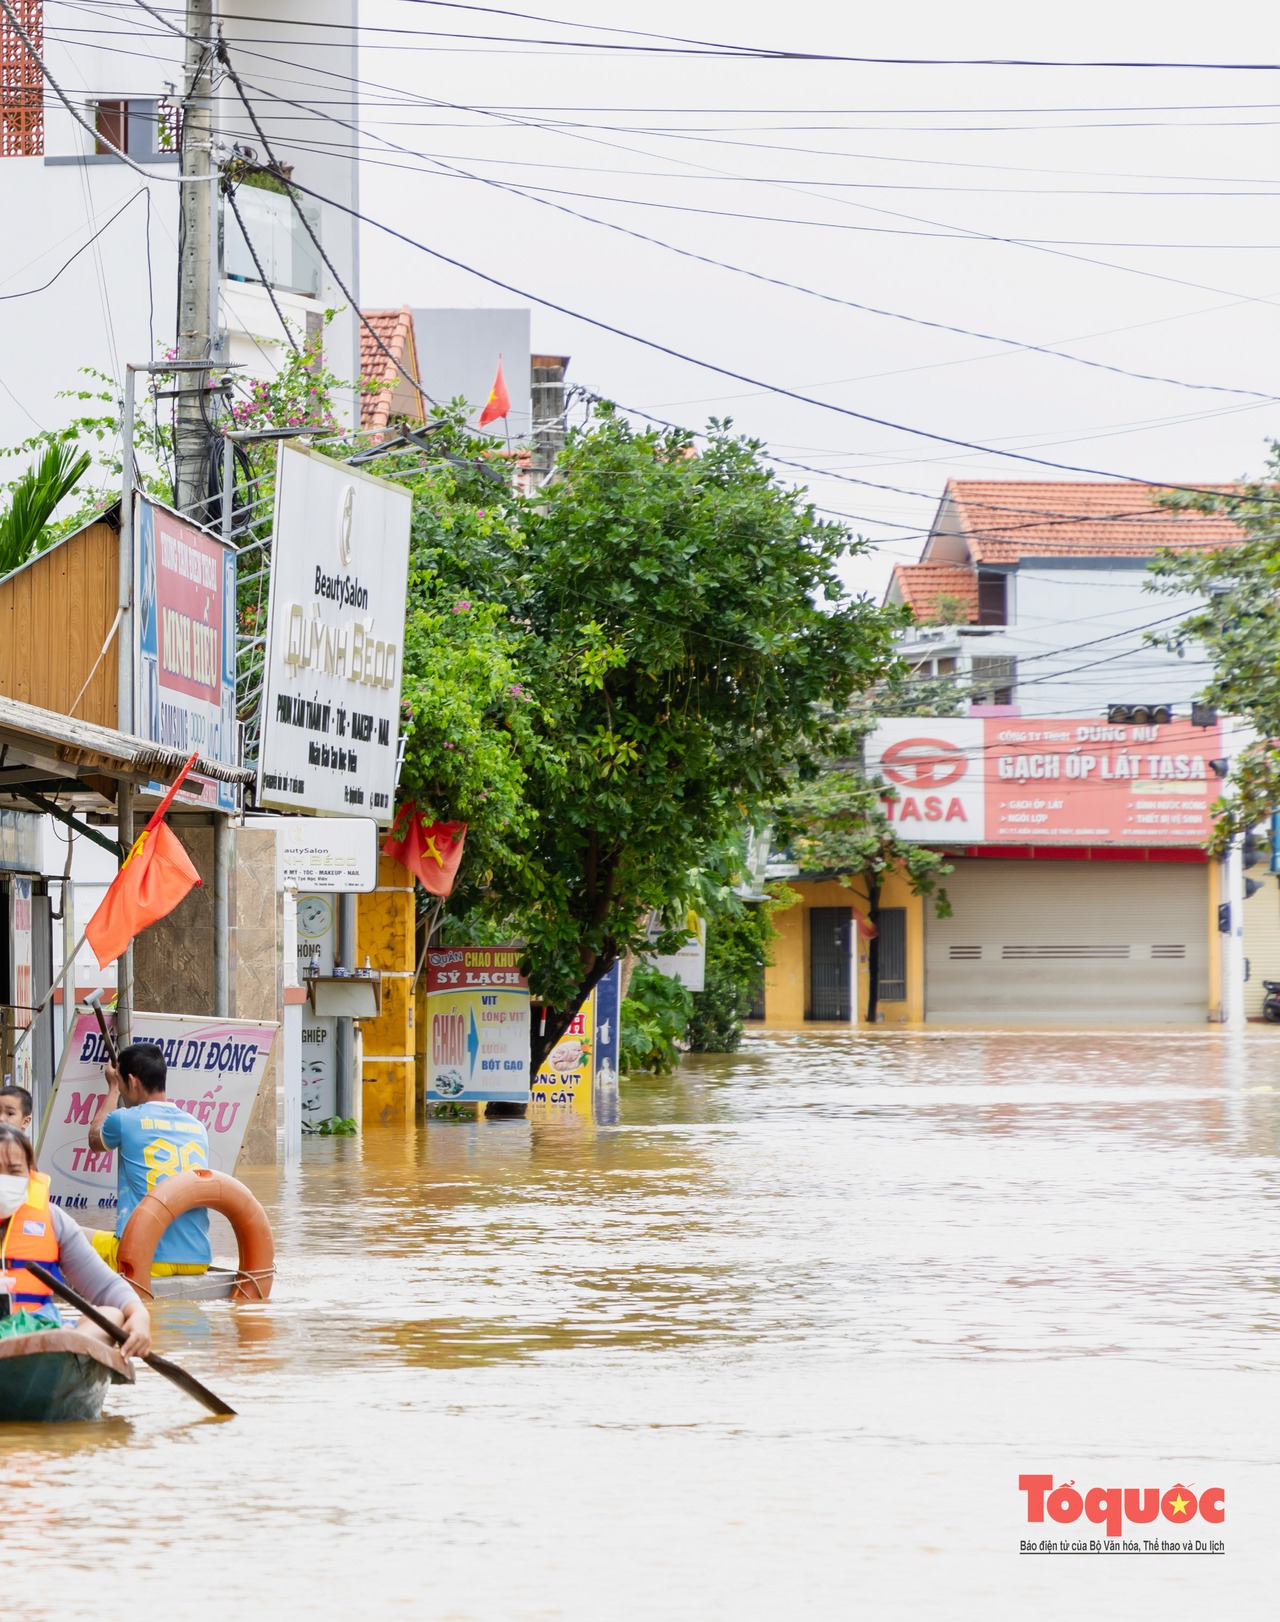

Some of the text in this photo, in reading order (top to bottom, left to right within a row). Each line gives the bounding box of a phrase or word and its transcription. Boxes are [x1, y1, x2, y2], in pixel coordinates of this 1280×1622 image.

[315, 565, 368, 611] BeautySalon
[162, 596, 218, 690] MINH HIẾU
[998, 747, 1206, 784] GẠCH ỐP LÁT TASA
[880, 796, 968, 821] TASA
[297, 940, 321, 958] HÒNG
[429, 950, 524, 967] QUÁN CHÁO KHUY
[437, 970, 520, 985] SỸ LẠCH
[302, 1027, 327, 1046] GHIỆP
[432, 1006, 465, 1066] CHÁO
[182, 1040, 206, 1069] DI
[204, 1035, 258, 1079] ĐỘNG
[482, 1059, 523, 1072] BỘT GẠO
[561, 1074, 581, 1089] VỊT
[532, 1092, 546, 1103] IM
